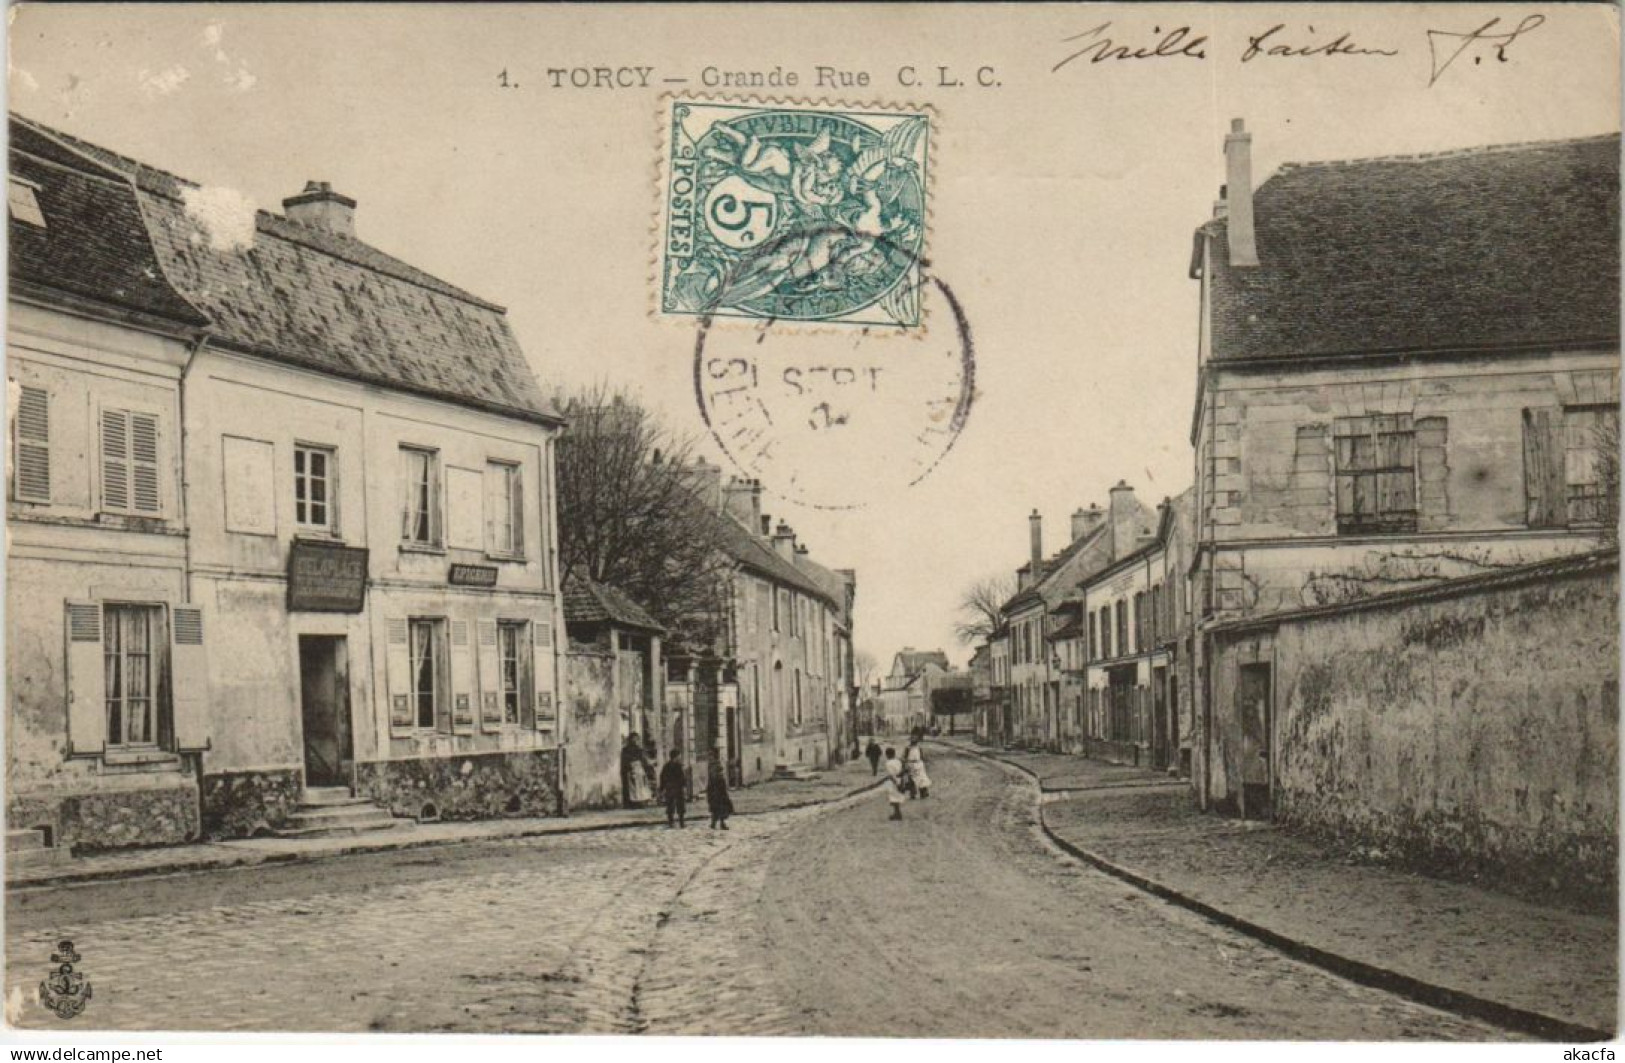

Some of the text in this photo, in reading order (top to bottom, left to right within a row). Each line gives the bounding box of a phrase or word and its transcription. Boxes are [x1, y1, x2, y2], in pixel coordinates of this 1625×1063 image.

[546, 66, 655, 90] TORCY
[701, 66, 799, 88] Grande
[815, 66, 871, 89] Rue
[897, 65, 923, 88] C.
[937, 66, 965, 88] L.
[976, 66, 1002, 88] C.
[670, 162, 695, 254] POSTES
